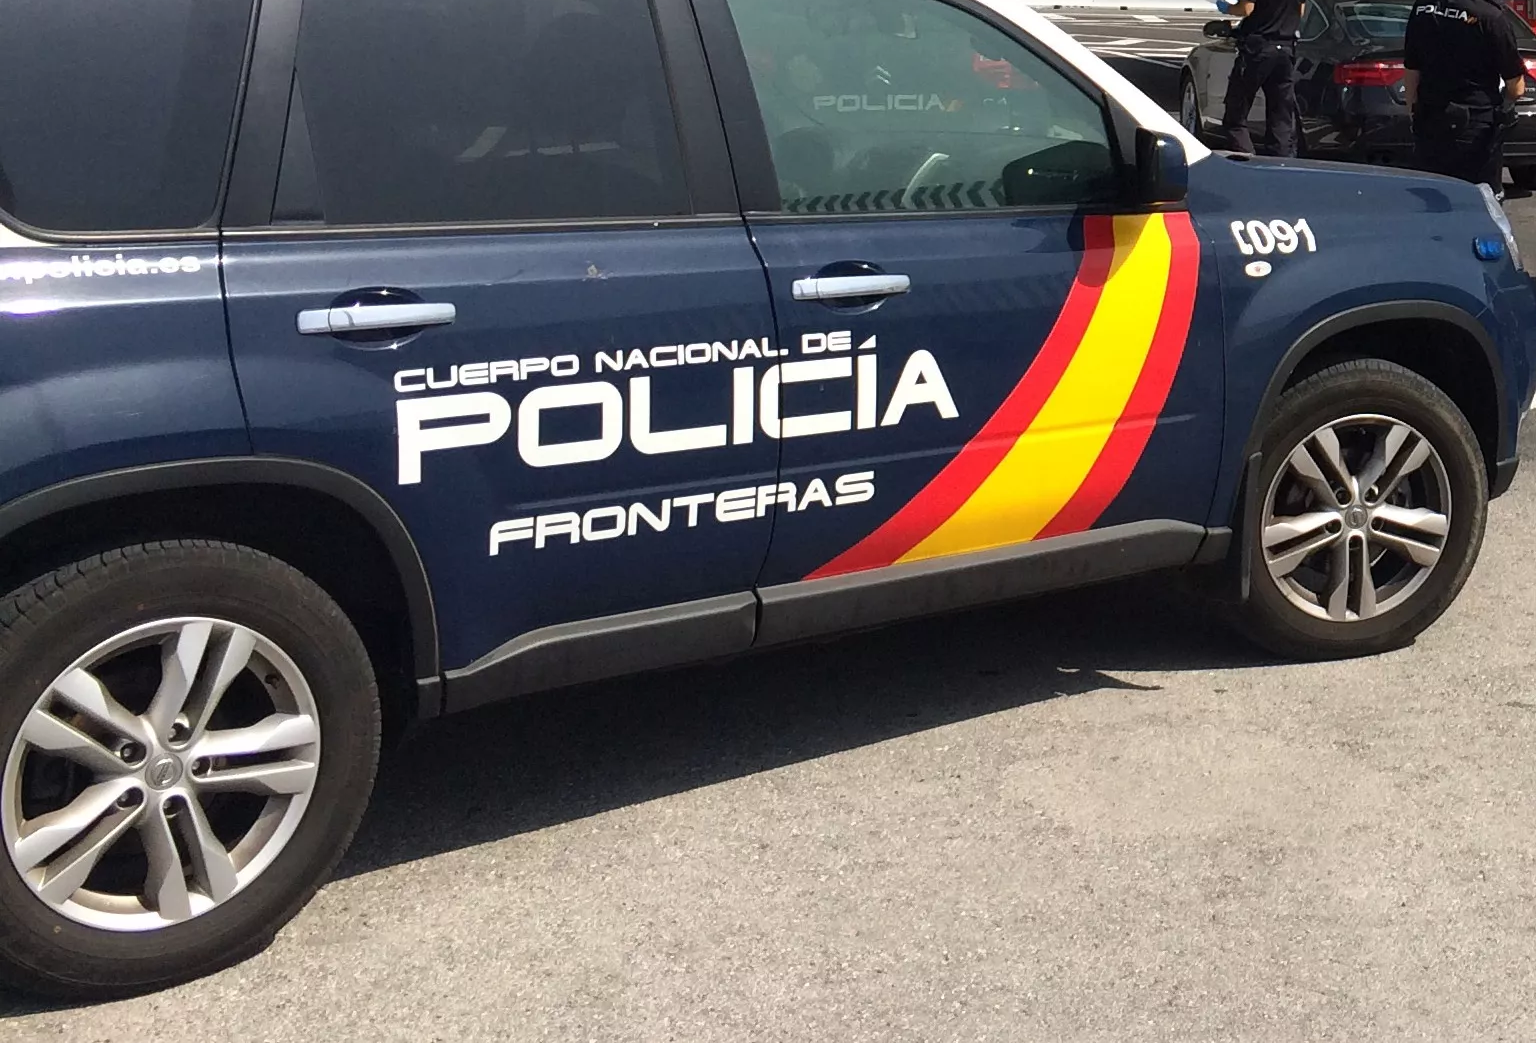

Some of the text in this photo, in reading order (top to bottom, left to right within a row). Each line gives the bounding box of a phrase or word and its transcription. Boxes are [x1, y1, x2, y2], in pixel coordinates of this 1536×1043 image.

[1415, 4, 1468, 22] POLICIA
[813, 93, 946, 112] POLICIA
[393, 330, 853, 393] CUERPO NACIONAL DE
[396, 334, 960, 486] POLICÍA
[488, 470, 876, 557] FRONTERAS
